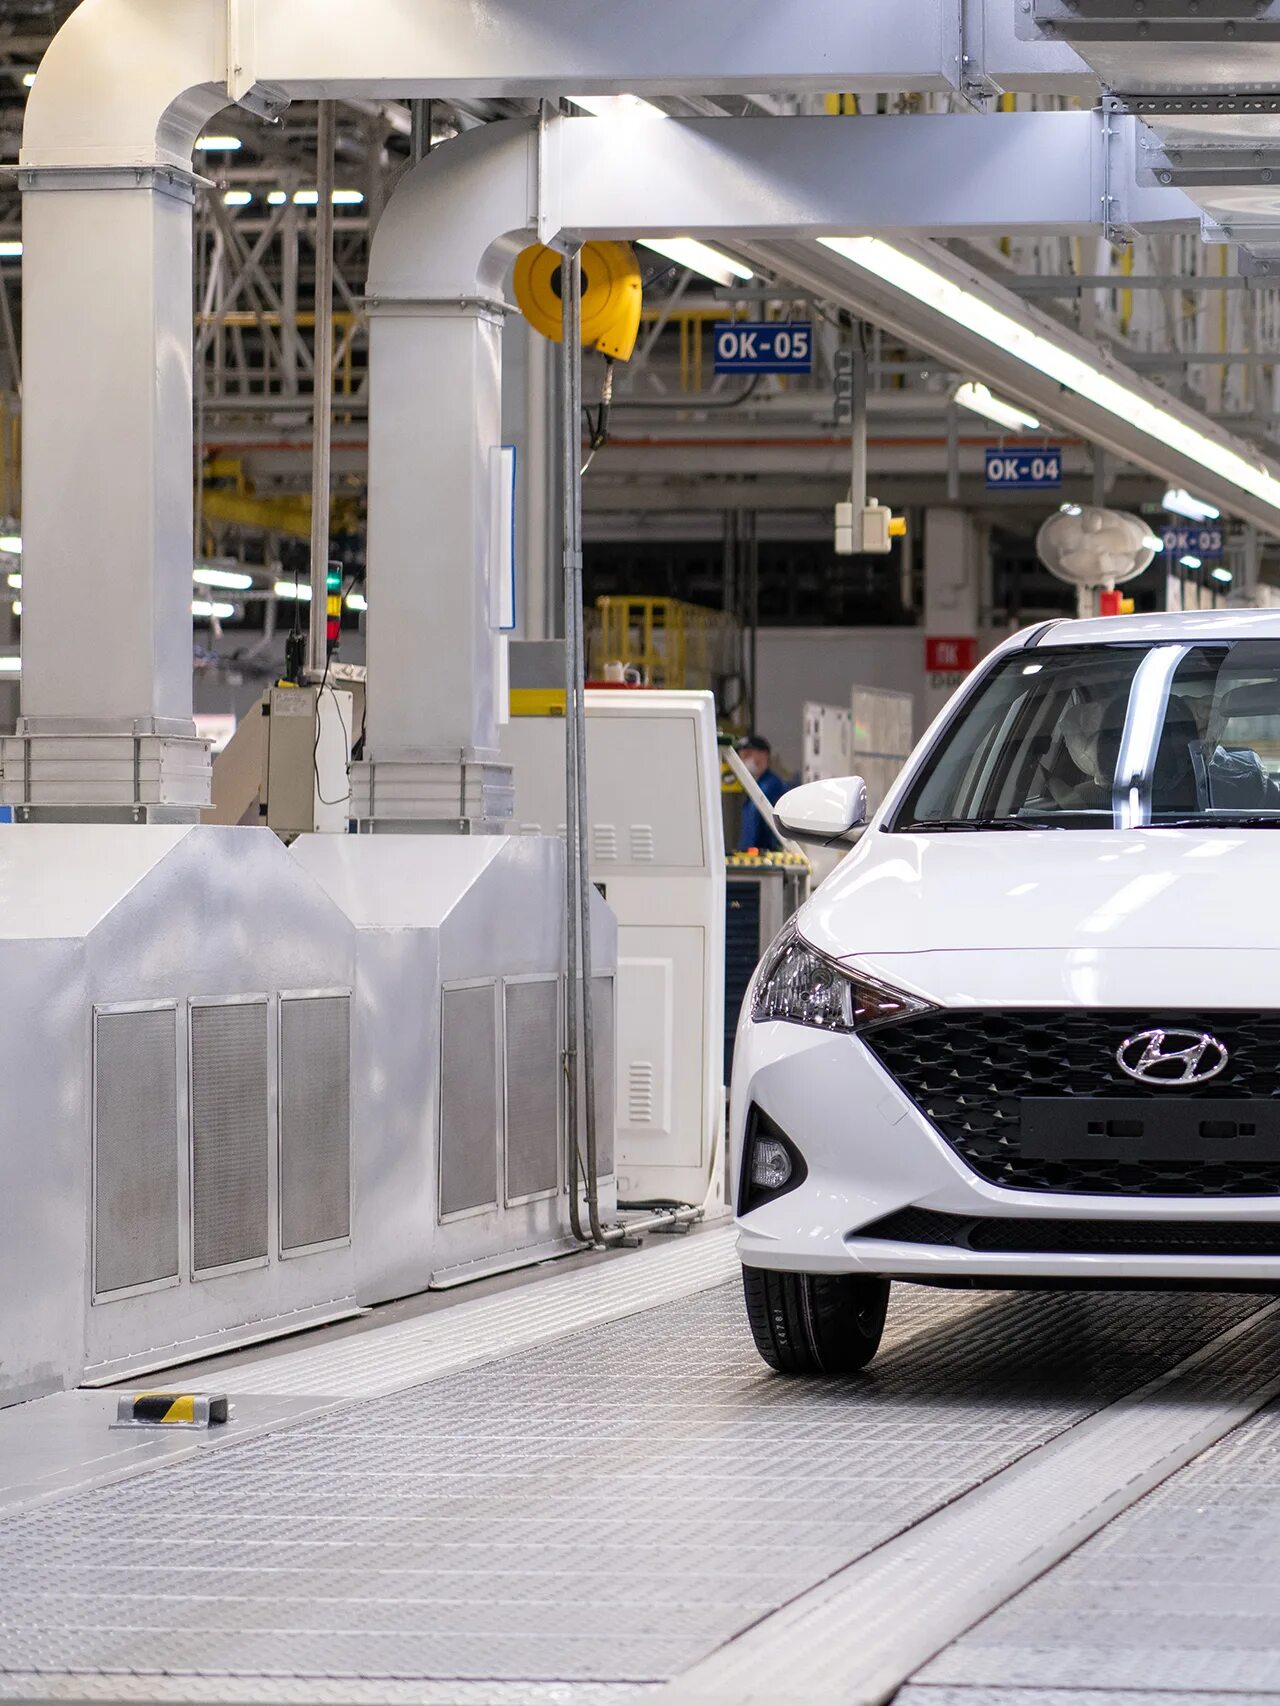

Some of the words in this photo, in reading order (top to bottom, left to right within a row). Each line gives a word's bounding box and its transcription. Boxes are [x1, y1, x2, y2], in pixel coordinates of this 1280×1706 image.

[718, 332, 808, 359] OK-05
[988, 458, 1059, 480] OK-04
[1163, 532, 1221, 550] OK-03
